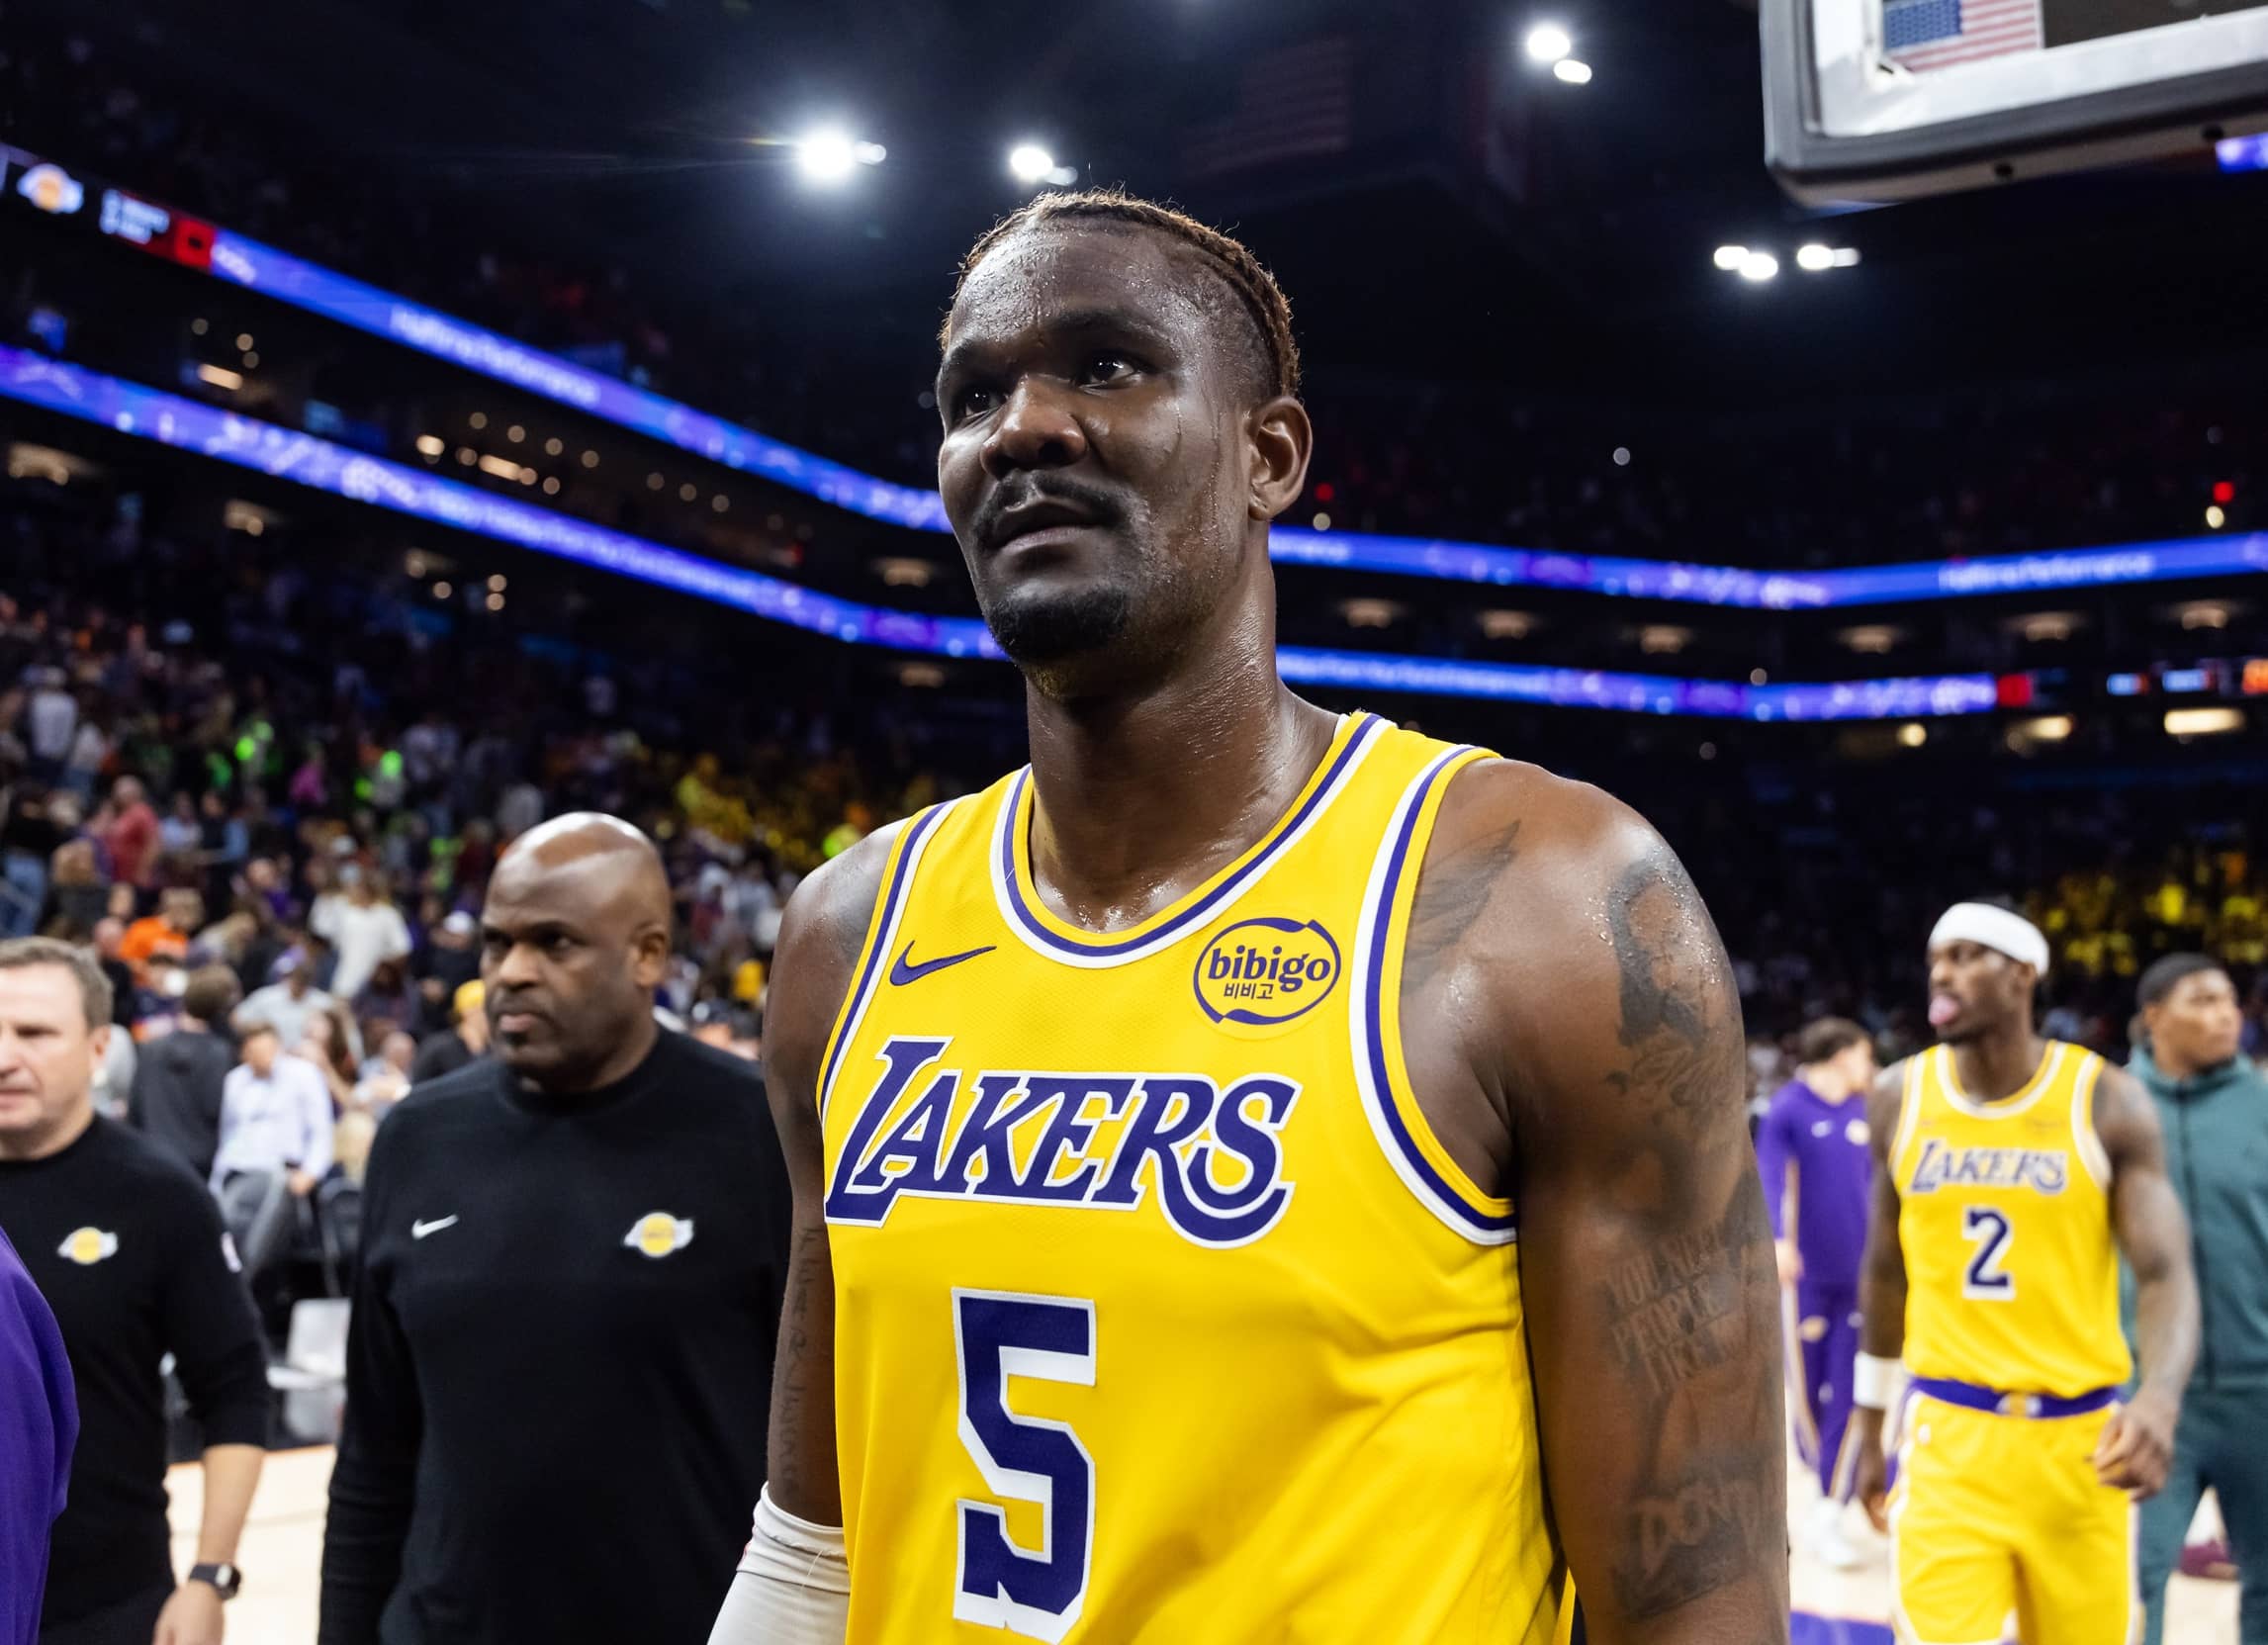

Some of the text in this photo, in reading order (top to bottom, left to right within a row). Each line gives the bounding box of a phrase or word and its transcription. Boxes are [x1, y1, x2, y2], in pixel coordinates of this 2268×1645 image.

[1208, 945, 1331, 993] bibigo
[1223, 982, 1274, 1000] 비비고
[823, 1036, 1303, 1249] LAKERS
[1908, 1137, 2069, 1196] LAKERS
[1961, 1205, 2017, 1302] 2
[951, 1286, 1097, 1645] 5
